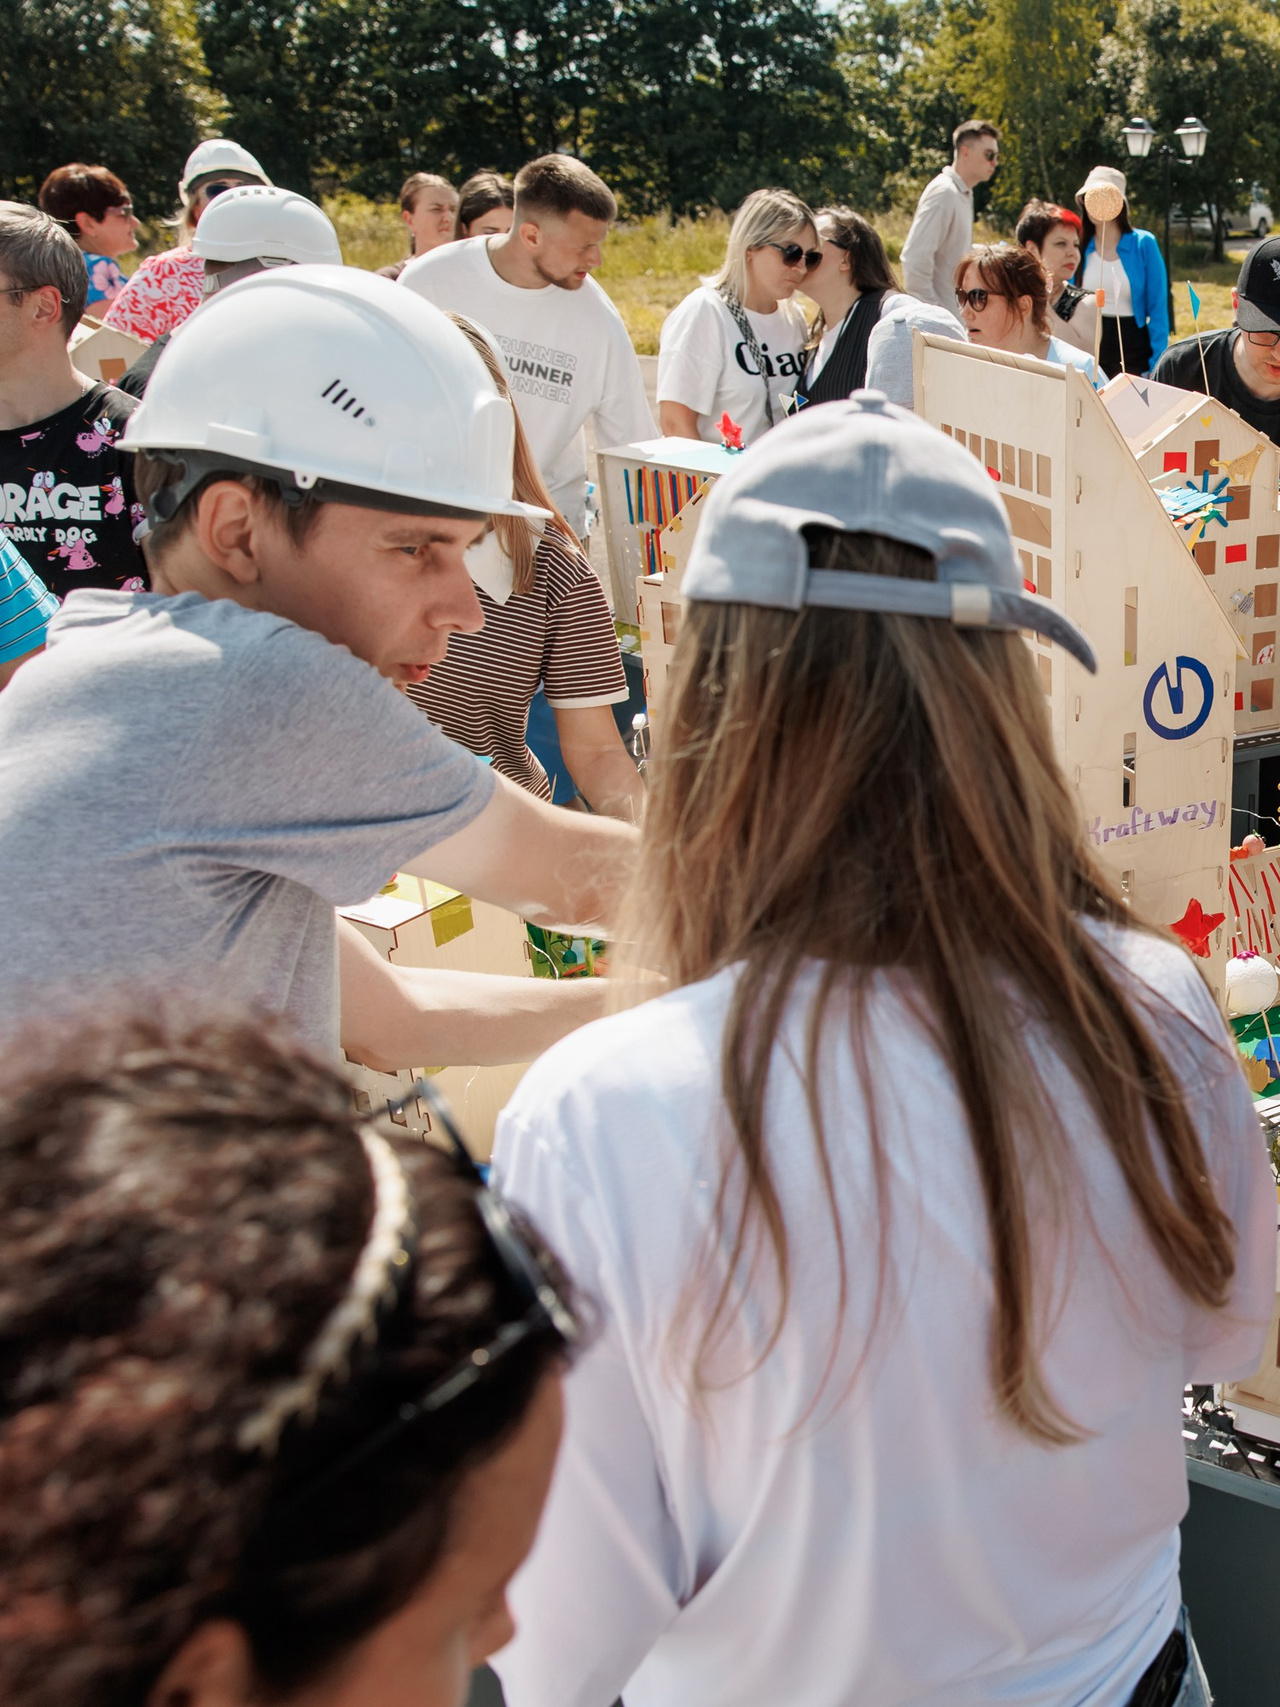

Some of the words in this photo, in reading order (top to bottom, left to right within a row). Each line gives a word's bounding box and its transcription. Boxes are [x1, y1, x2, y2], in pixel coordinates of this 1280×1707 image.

[504, 355, 573, 387] UNNER
[54, 526, 98, 545] DOG
[1083, 800, 1217, 846] Kraftway
